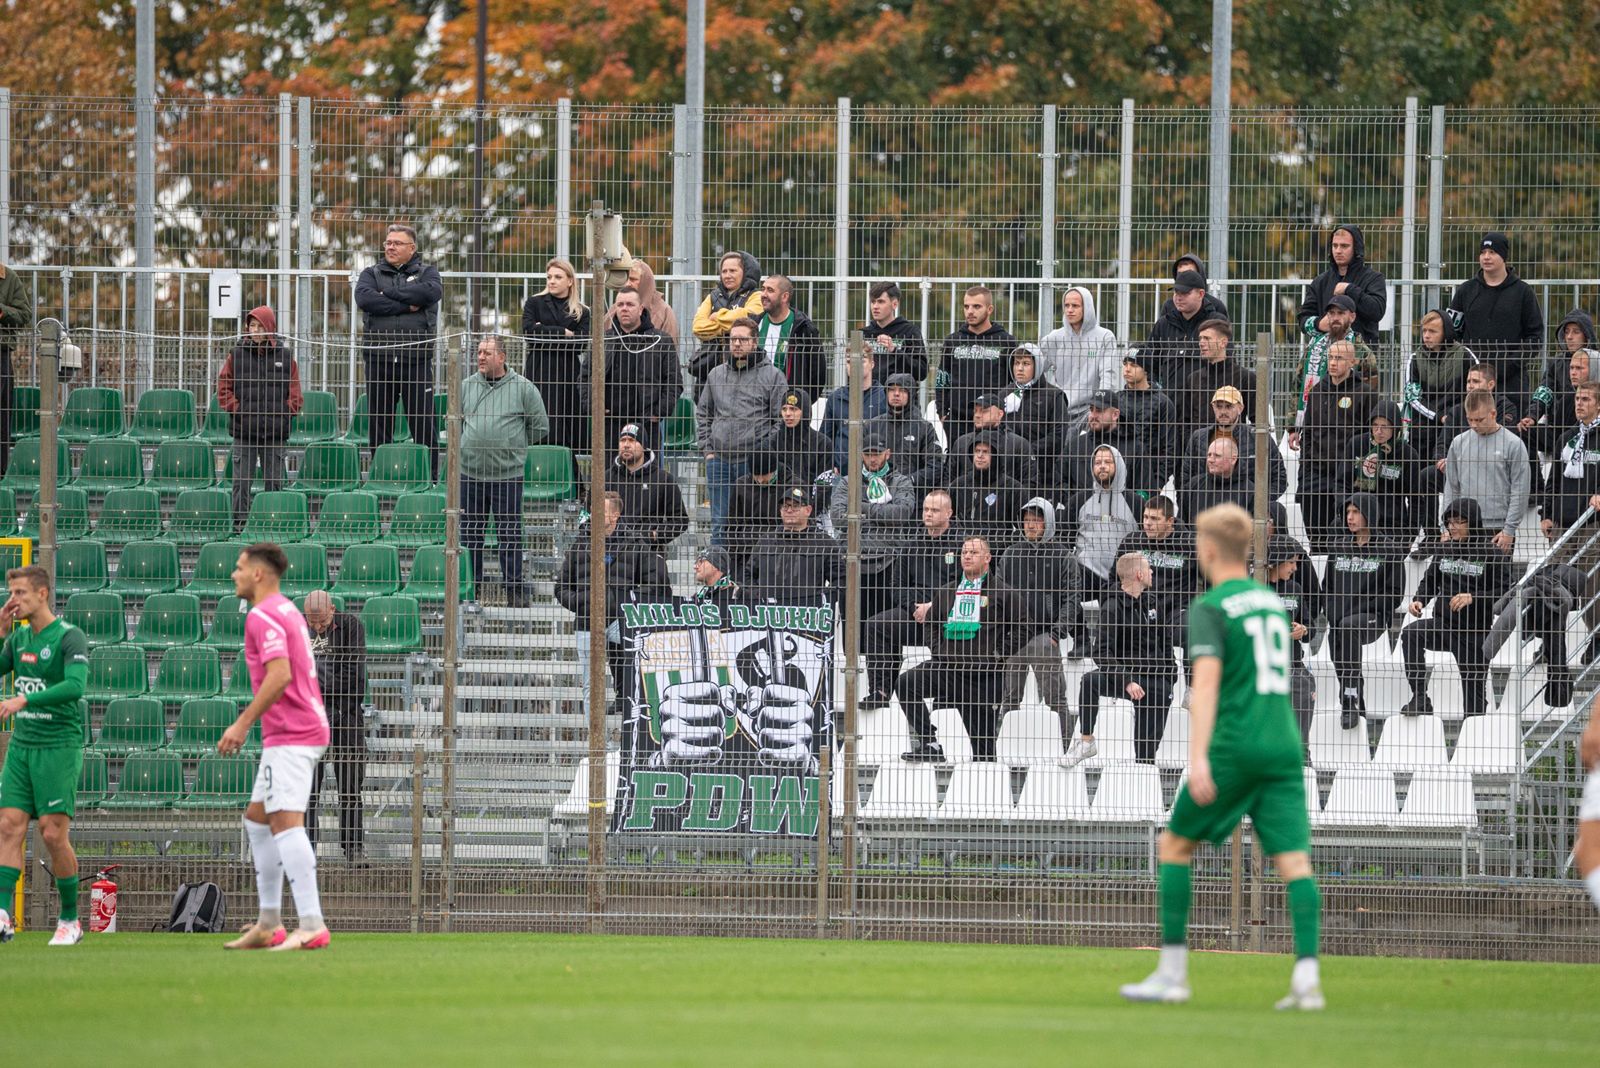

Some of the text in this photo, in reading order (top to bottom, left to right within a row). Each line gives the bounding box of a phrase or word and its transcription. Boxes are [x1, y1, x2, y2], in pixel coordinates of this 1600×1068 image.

[218, 285, 231, 307] F
[621, 600, 721, 628] MILOŠ
[1243, 614, 1291, 695] 19
[264, 765, 272, 790] 9
[623, 771, 820, 837] PDW
